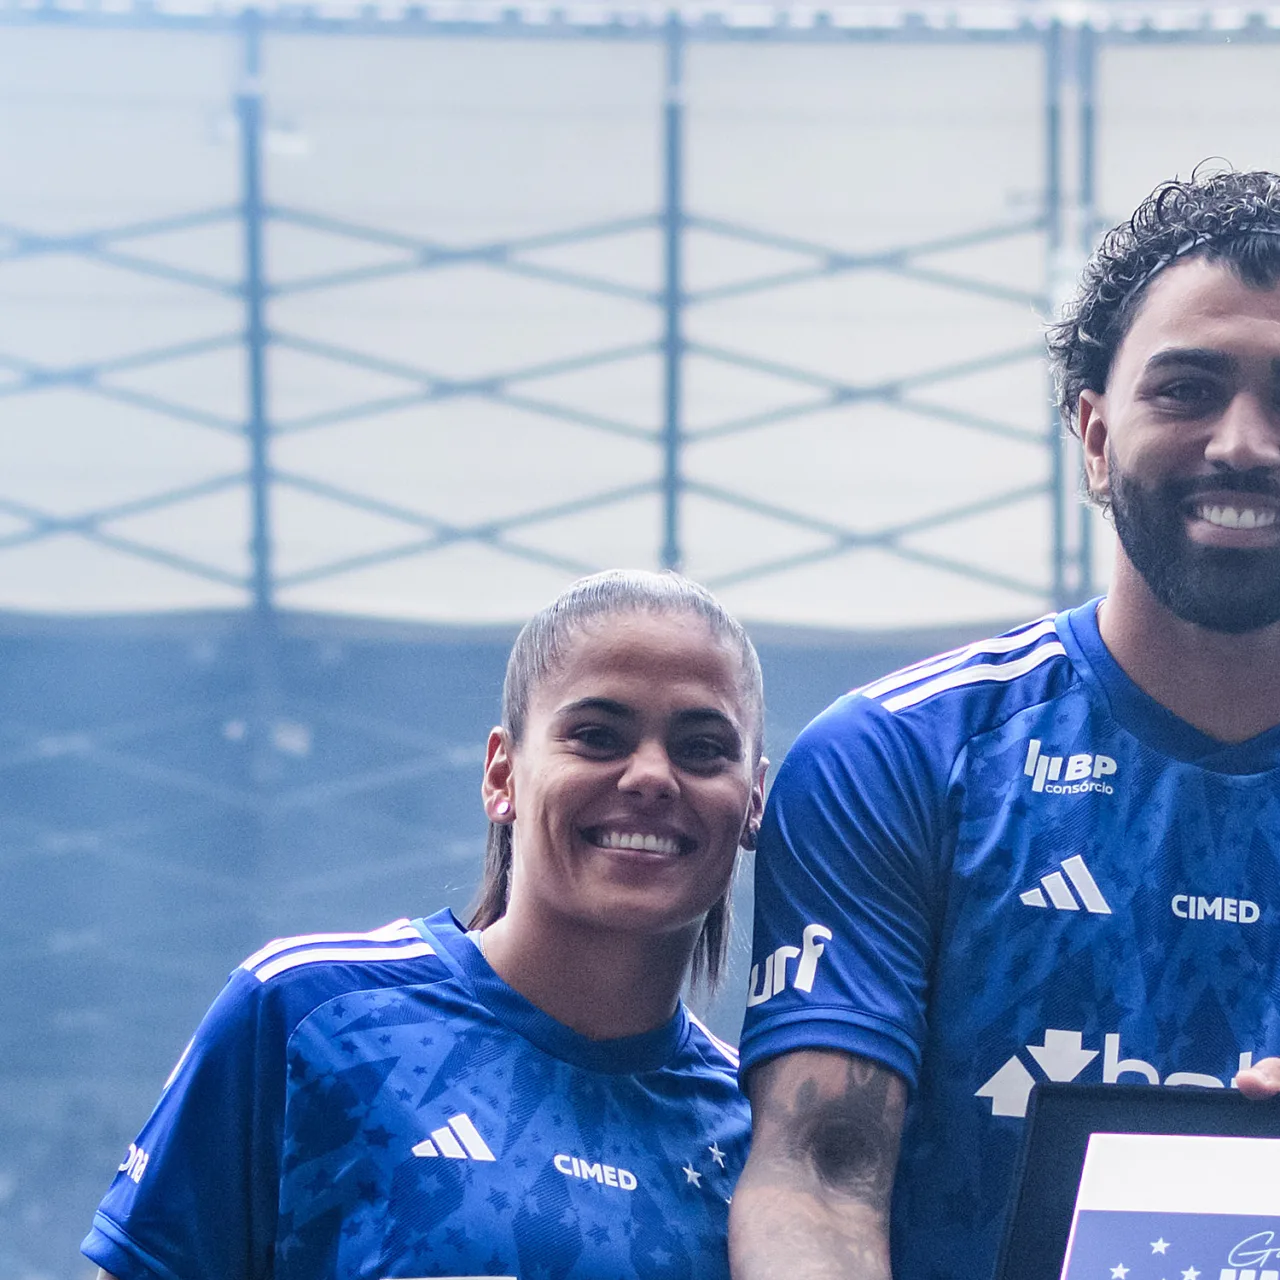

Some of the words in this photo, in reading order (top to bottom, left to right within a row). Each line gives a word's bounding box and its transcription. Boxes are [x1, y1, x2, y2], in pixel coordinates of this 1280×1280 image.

[1064, 753, 1117, 781] BP
[1045, 780, 1114, 795] consórcio
[1171, 894, 1260, 924] CIMED
[553, 1153, 638, 1191] CIMED
